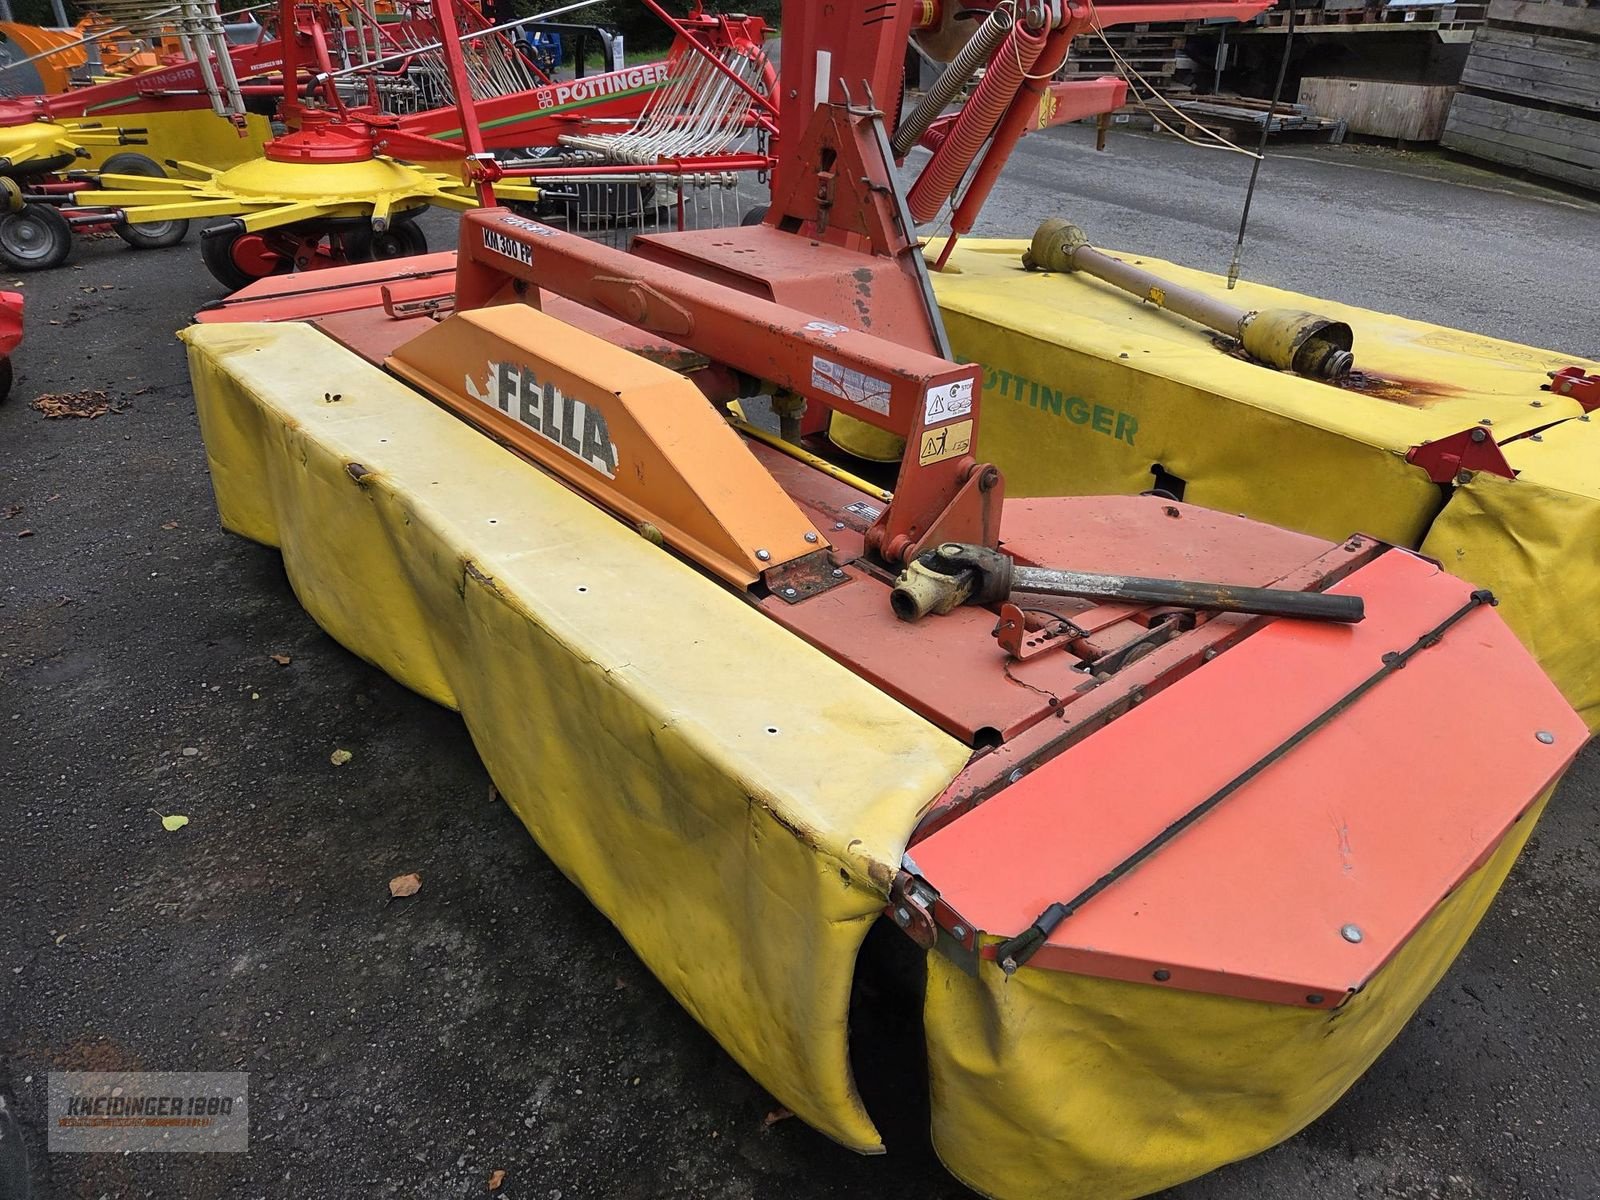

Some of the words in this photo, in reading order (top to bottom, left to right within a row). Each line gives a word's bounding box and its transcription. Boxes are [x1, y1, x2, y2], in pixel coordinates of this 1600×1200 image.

[556, 65, 669, 105] PÖTTINGER
[484, 228, 499, 251] KM
[500, 235, 518, 258] 300
[520, 242, 532, 263] FP
[499, 360, 616, 476] FELLA
